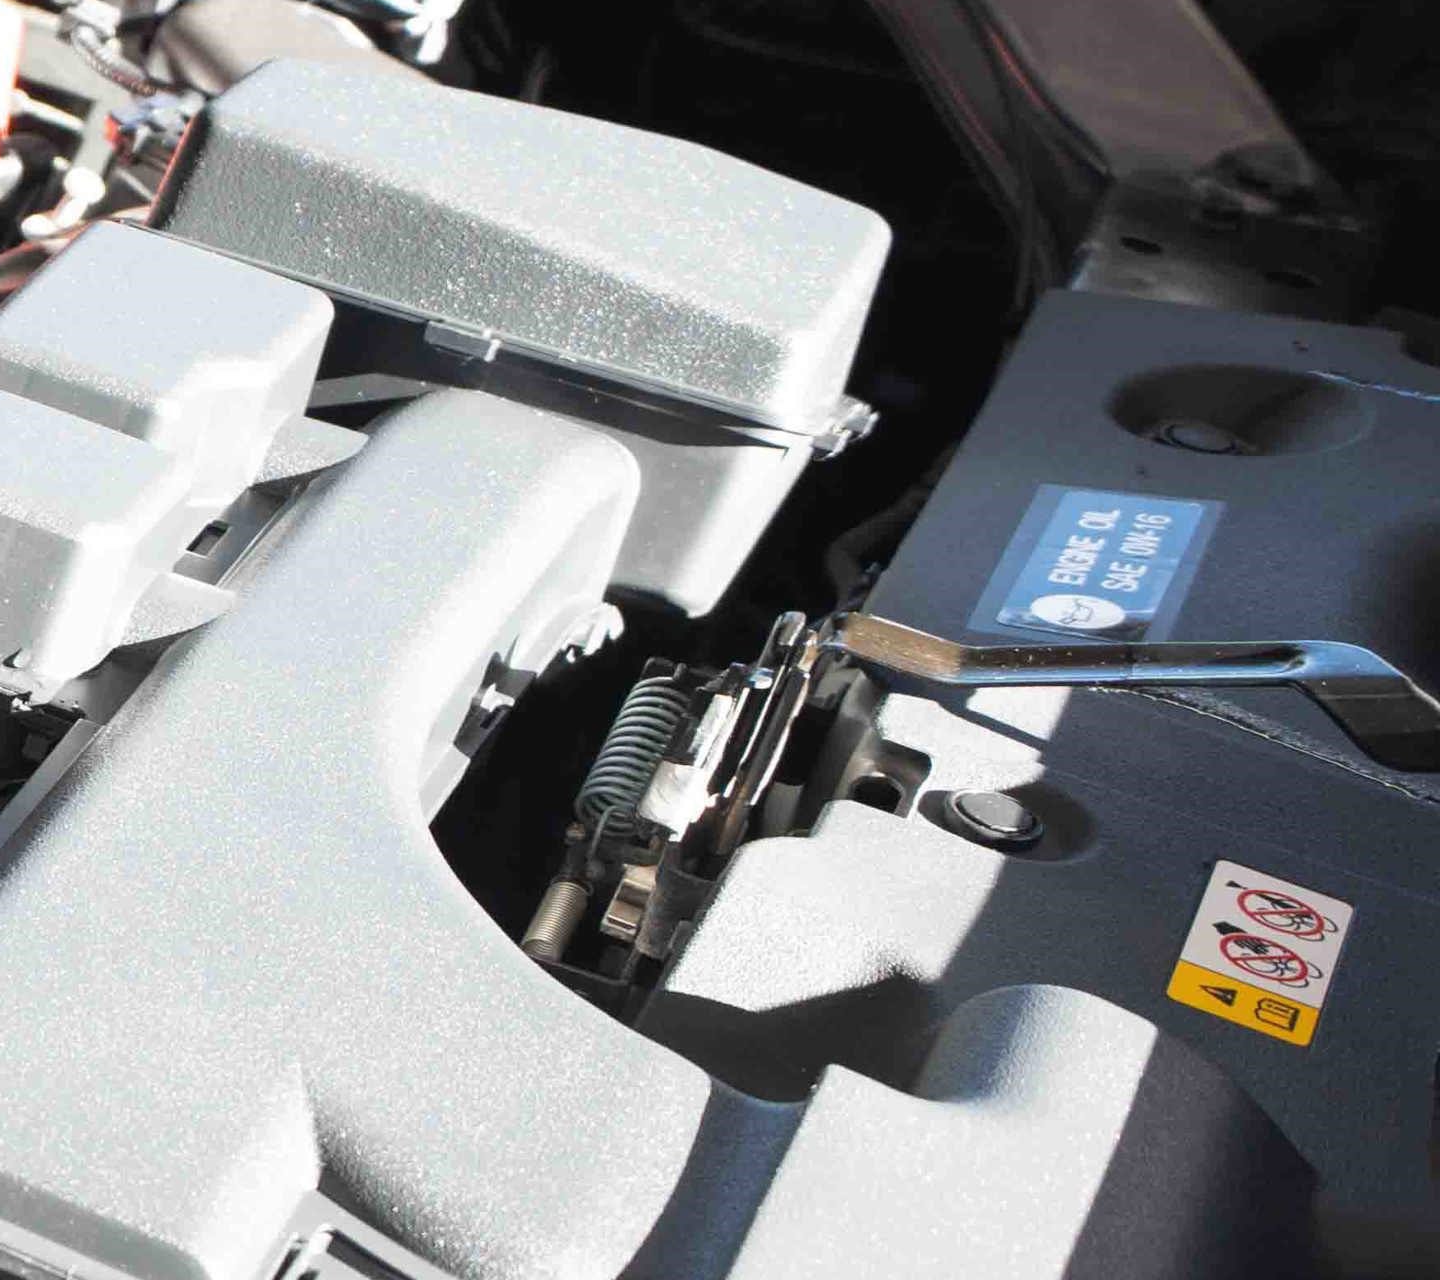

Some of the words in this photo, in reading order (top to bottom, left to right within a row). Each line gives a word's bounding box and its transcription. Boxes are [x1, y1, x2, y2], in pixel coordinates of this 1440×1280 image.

[1048, 534, 1106, 585] ENGINE
[1078, 509, 1121, 530] OIL
[1119, 512, 1173, 556] 0W-16
[1101, 560, 1148, 592] SAE
